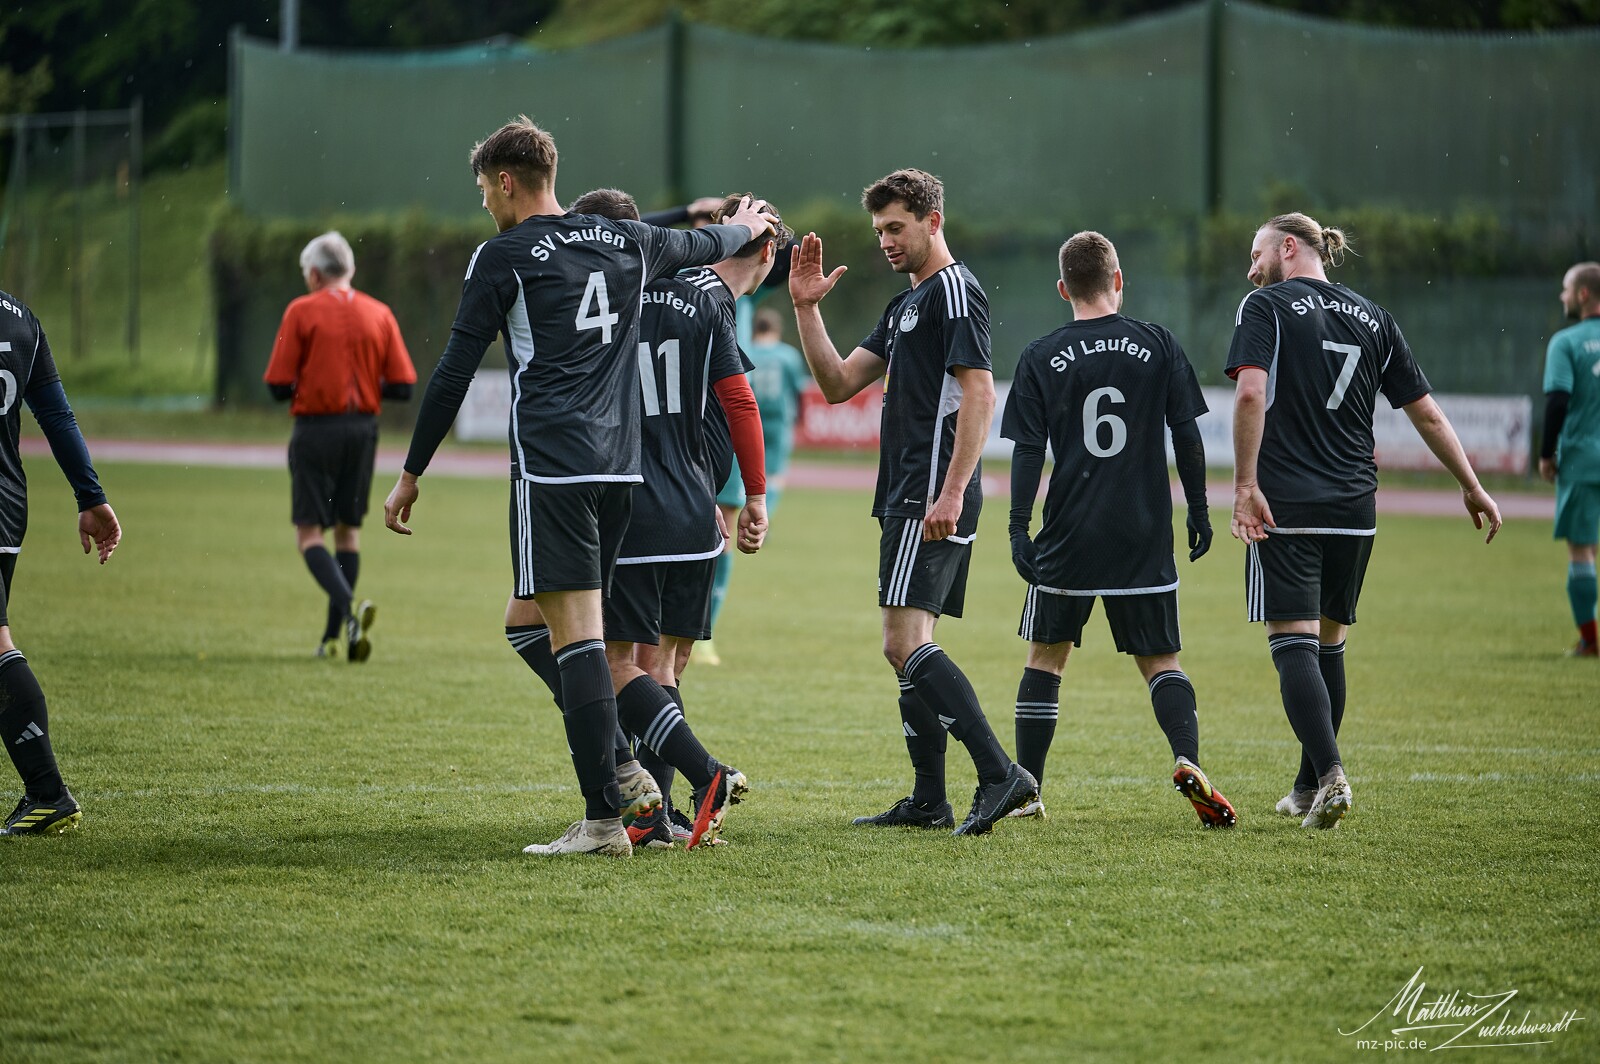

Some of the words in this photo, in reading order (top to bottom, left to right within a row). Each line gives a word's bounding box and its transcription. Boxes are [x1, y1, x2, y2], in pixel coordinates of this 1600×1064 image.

[531, 234, 556, 262] SV
[555, 225, 626, 249] Laufen
[0, 296, 23, 318] en
[574, 270, 619, 345] 4
[1291, 295, 1316, 316] SV
[1317, 295, 1380, 333] Laufen
[1050, 345, 1076, 373] SV
[1080, 336, 1152, 363] Laufen
[1322, 339, 1362, 410] 7
[1082, 386, 1128, 458] 6
